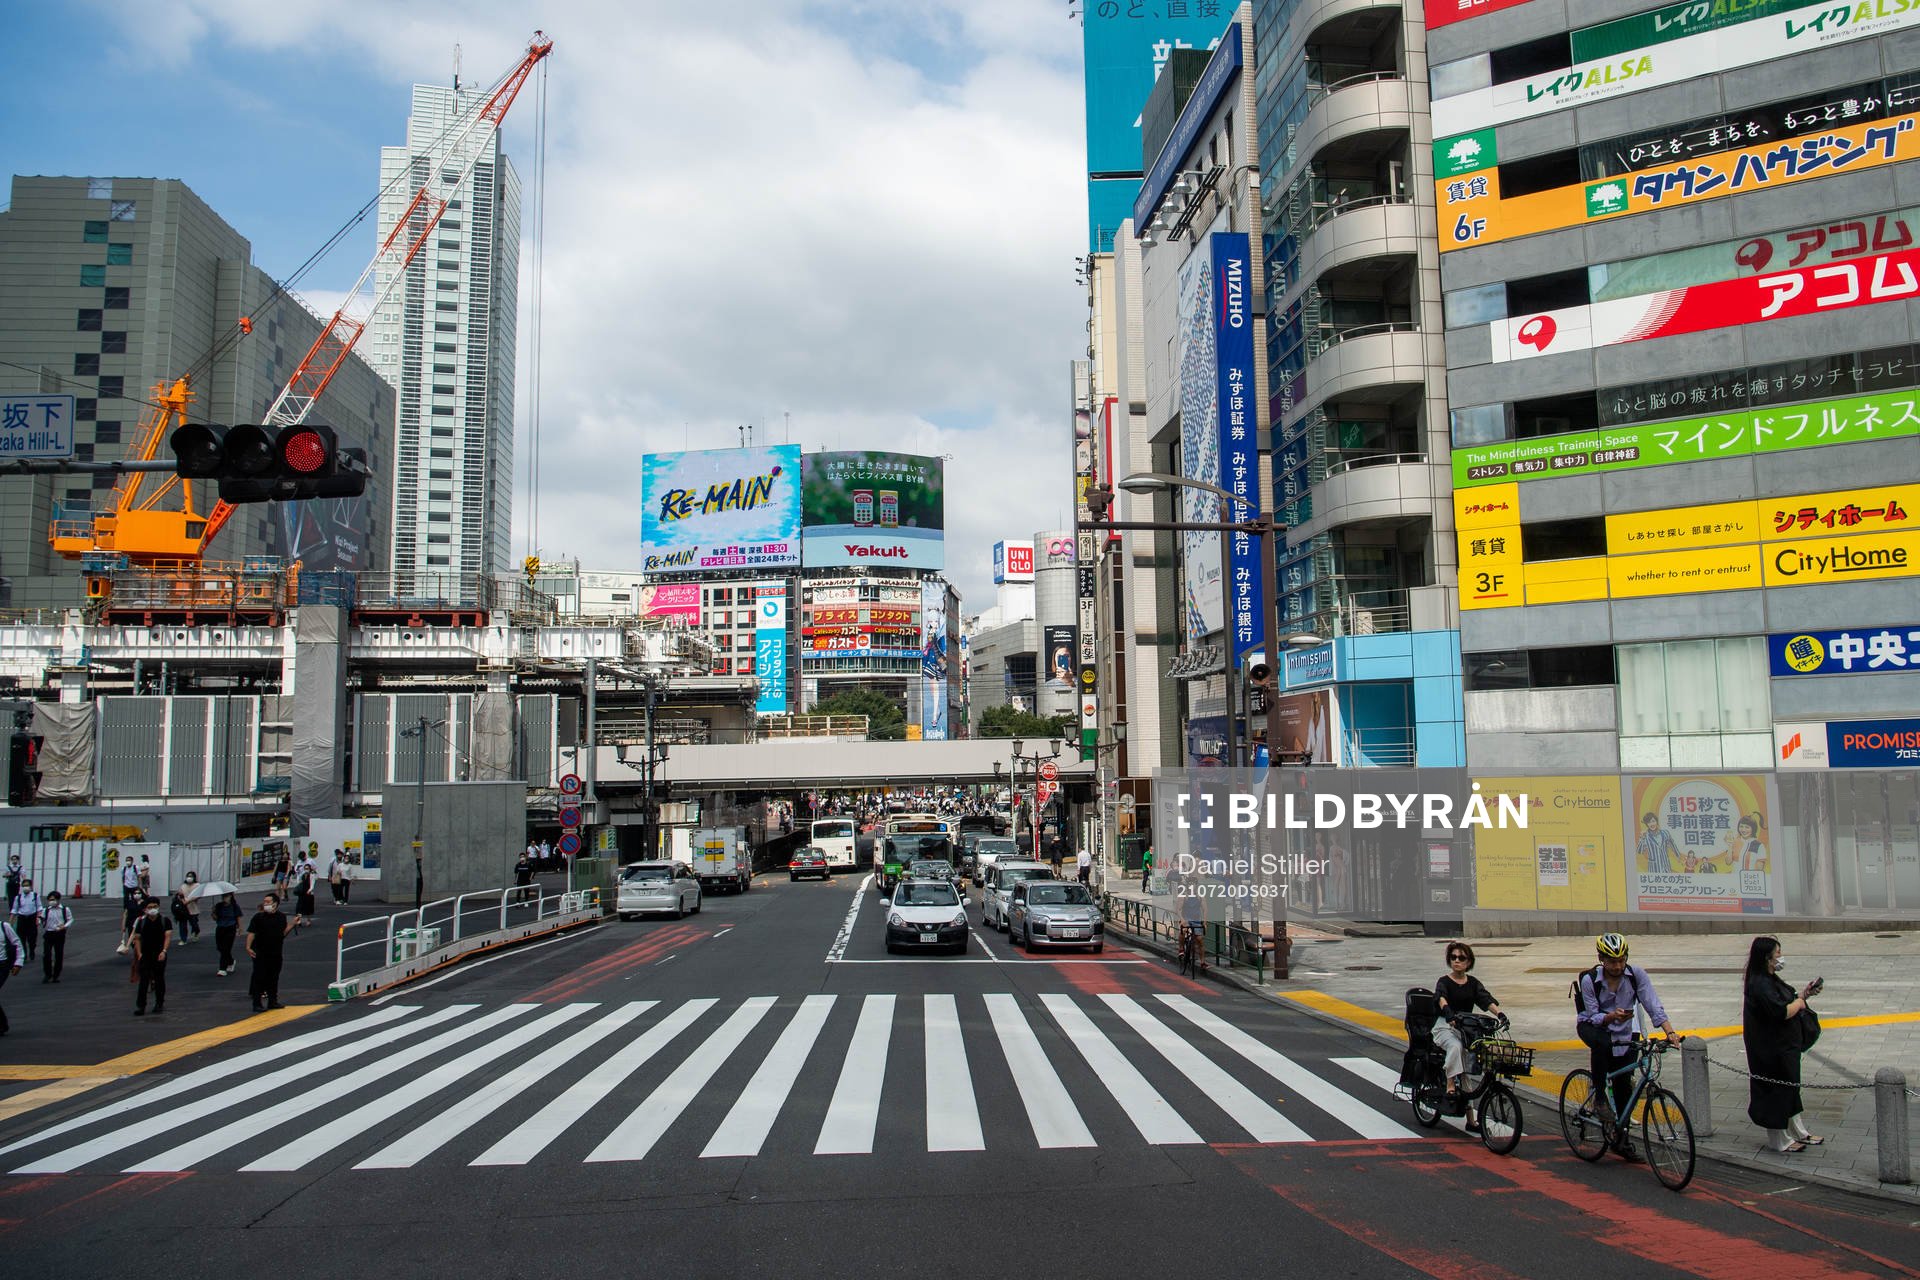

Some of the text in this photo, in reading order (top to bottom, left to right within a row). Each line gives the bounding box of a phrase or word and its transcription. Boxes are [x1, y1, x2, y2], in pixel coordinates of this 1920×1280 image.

[1527, 55, 1653, 102] レイクALSA
[1633, 119, 1914, 203] タウンハウジング
[1447, 177, 1488, 203] 賃貸
[1454, 213, 1487, 242] 6F
[1787, 215, 1913, 267] アコム
[1228, 258, 1244, 329] MIZUHO
[1759, 257, 1919, 317] アコム
[1229, 367, 1246, 440] みずほ証券
[2, 402, 63, 429] 坂下
[1653, 400, 1920, 455] マインドフルネス
[28, 431, 65, 450] Hill-L.
[1467, 434, 1639, 464] The Mindfulness Training Space
[1554, 455, 1585, 468] 集中力
[1595, 448, 1637, 463] 自律神経
[1471, 467, 1505, 478] ストレス
[1514, 460, 1545, 473] 無気力
[1465, 501, 1510, 514] シティホーム
[1773, 501, 1908, 533] シティホーム
[1627, 521, 1744, 541] しあわせ探し 部屋さがし
[844, 545, 909, 558] Yakult
[1010, 551, 1029, 560] UNI
[1471, 537, 1506, 557] 賃貸
[1011, 562, 1031, 572] QLO
[1775, 545, 1908, 576] CityHome
[1627, 563, 1751, 582] whether to rent or entrust
[1475, 572, 1505, 593] 3F
[1081, 601, 1093, 610] 3F
[1236, 567, 1253, 642] みずほ銀行
[828, 638, 854, 648] ガスト
[1790, 637, 1816, 660] 瞳
[1795, 654, 1823, 669] イキイキ
[1553, 795, 1611, 809] CityHome
[1678, 796, 1730, 813] 15秒で
[1667, 814, 1731, 830] 事前審査
[1684, 830, 1716, 846] 回答
[1640, 874, 1692, 884] はじめての方に
[1641, 885, 1726, 895] プロミスのアプリローン
